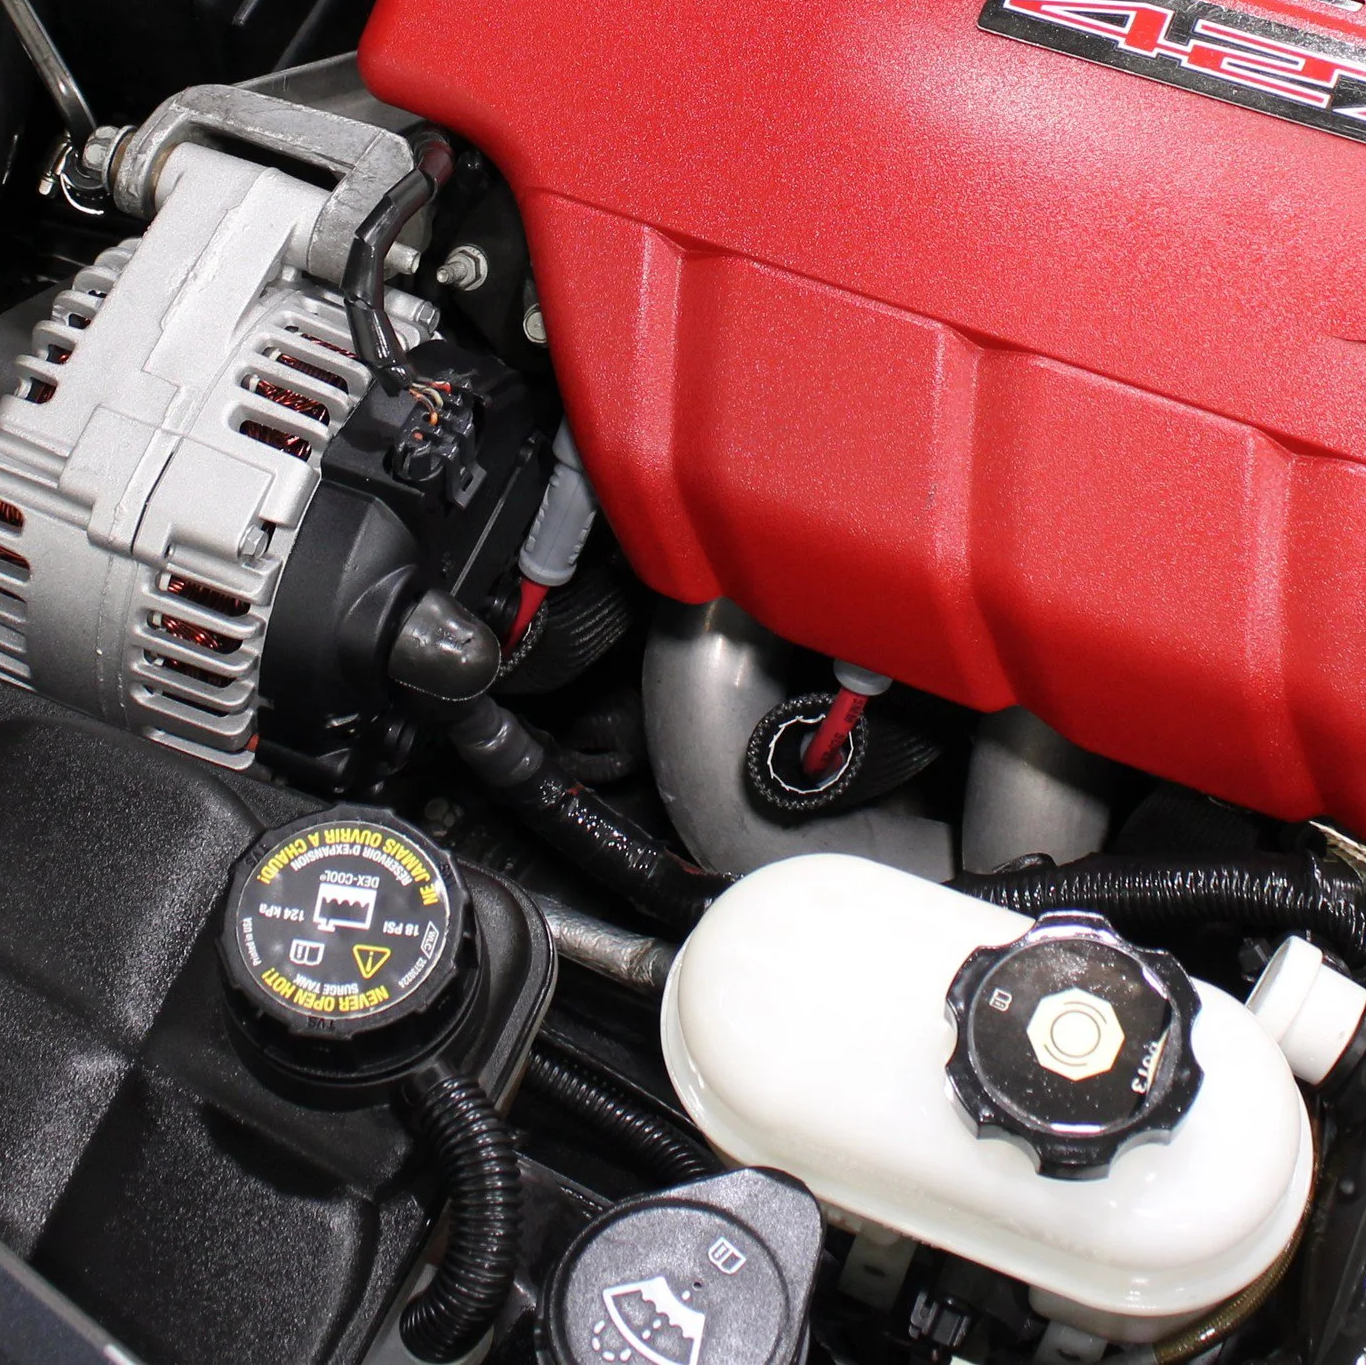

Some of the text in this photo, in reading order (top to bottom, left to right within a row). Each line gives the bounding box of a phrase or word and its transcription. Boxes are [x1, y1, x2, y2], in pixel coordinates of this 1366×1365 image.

[307, 831, 319, 847] A
[324, 828, 383, 848] OUVRIR
[256, 838, 307, 884] CHAUD!
[290, 843, 361, 871] D'EXPANSION
[362, 846, 413, 886] RÉSERVOIR
[382, 838, 431, 882] JAMAIS
[419, 883, 439, 906] NE
[259, 903, 305, 922] 124 kPa
[242, 917, 253, 933] USA
[383, 921, 419, 937] 18 PSI
[424, 930, 436, 950] WLC
[261, 967, 390, 1012] NEVER OPEN HOT!
[293, 973, 359, 996] SURGE TANK
